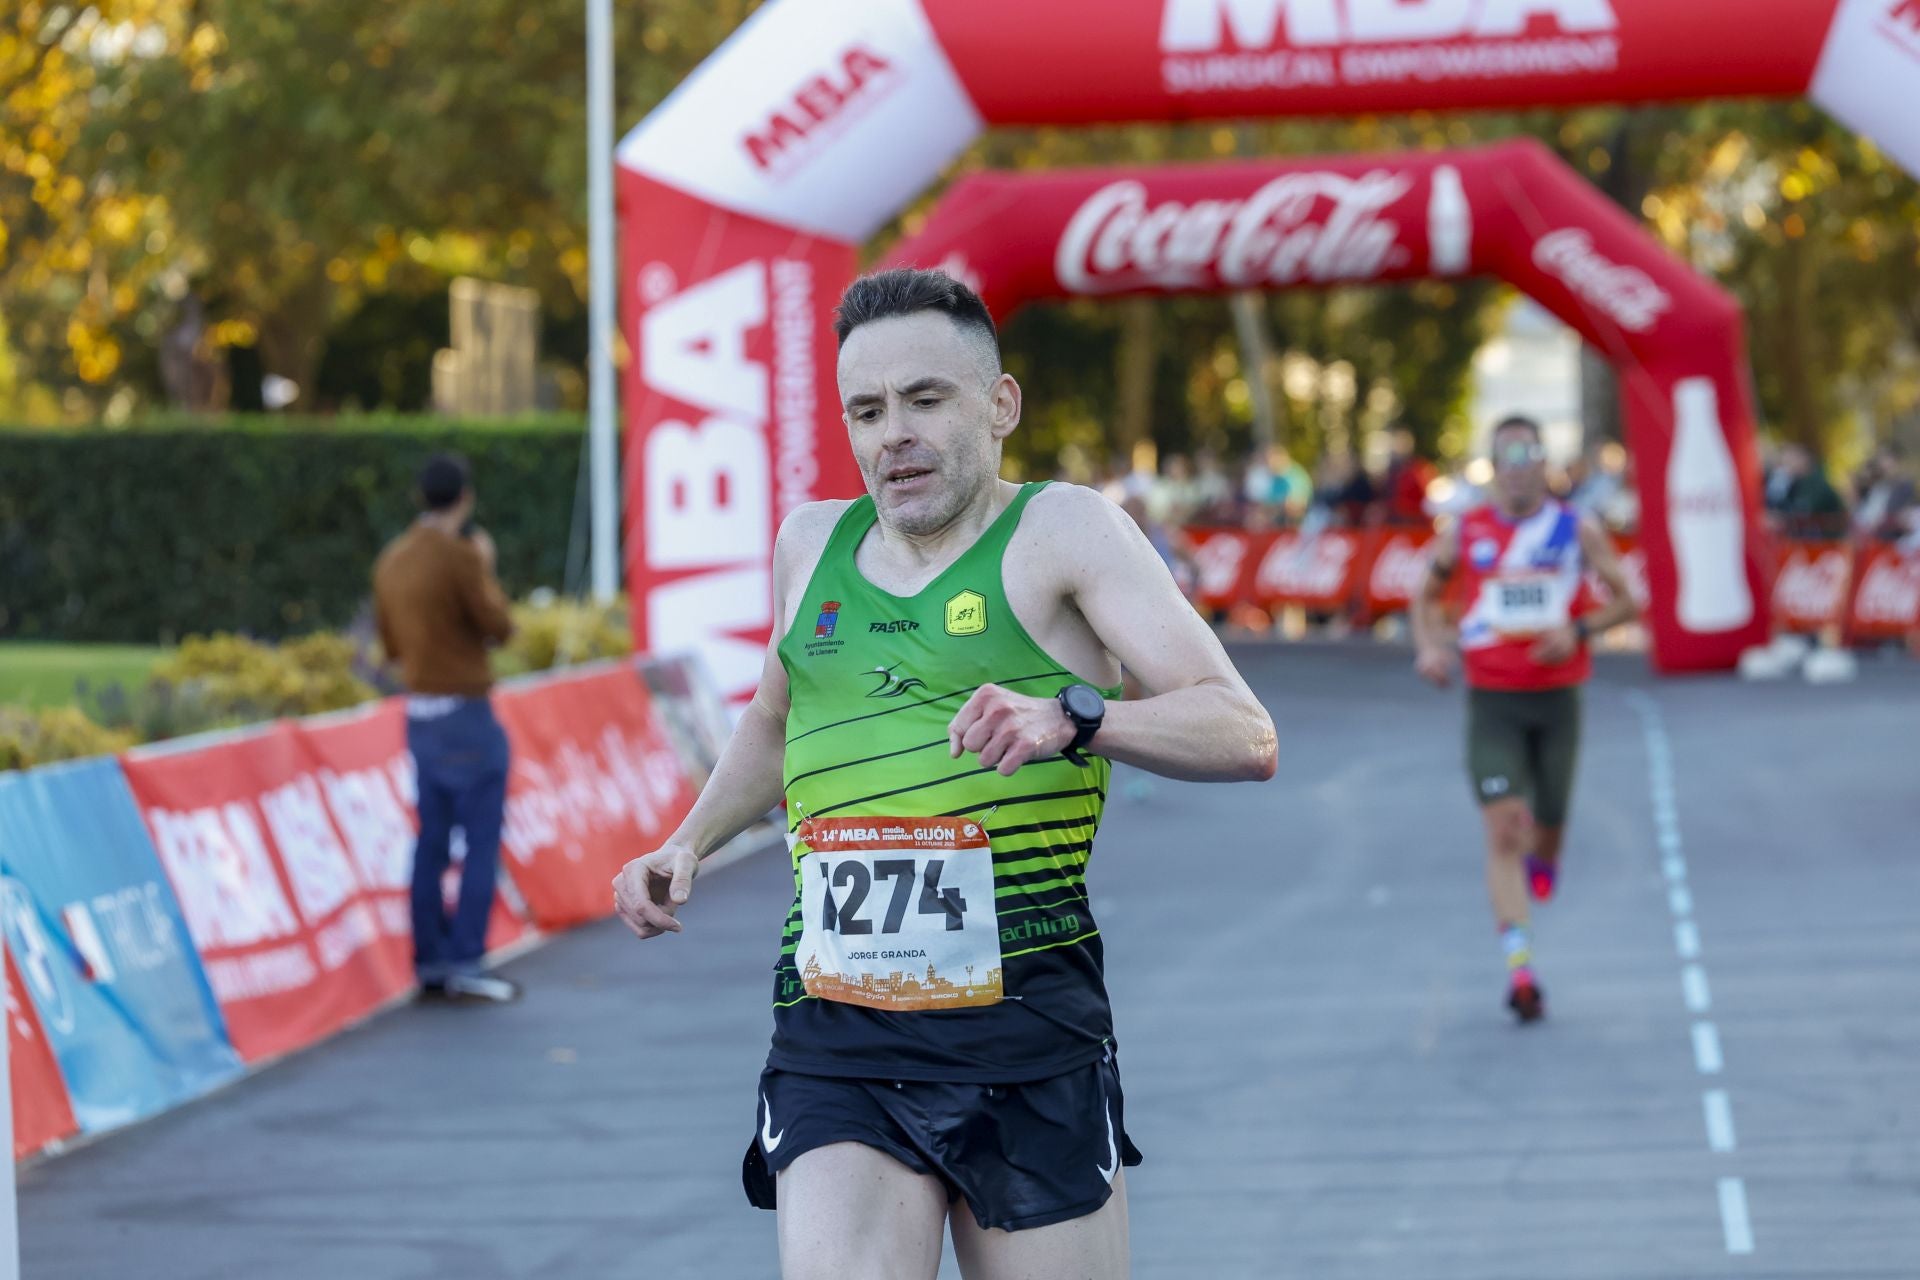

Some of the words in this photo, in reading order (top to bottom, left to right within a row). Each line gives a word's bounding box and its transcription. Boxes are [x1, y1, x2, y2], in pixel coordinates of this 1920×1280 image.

[743, 46, 891, 170] MBA
[869, 620, 920, 632] FASTER
[804, 639, 845, 649] Ayuntamiento
[838, 827, 880, 842] MBA
[882, 833, 912, 841] maratón
[914, 825, 955, 841] GIJÓN
[847, 950, 879, 960] JORGE
[880, 949, 927, 960] GRANDA
